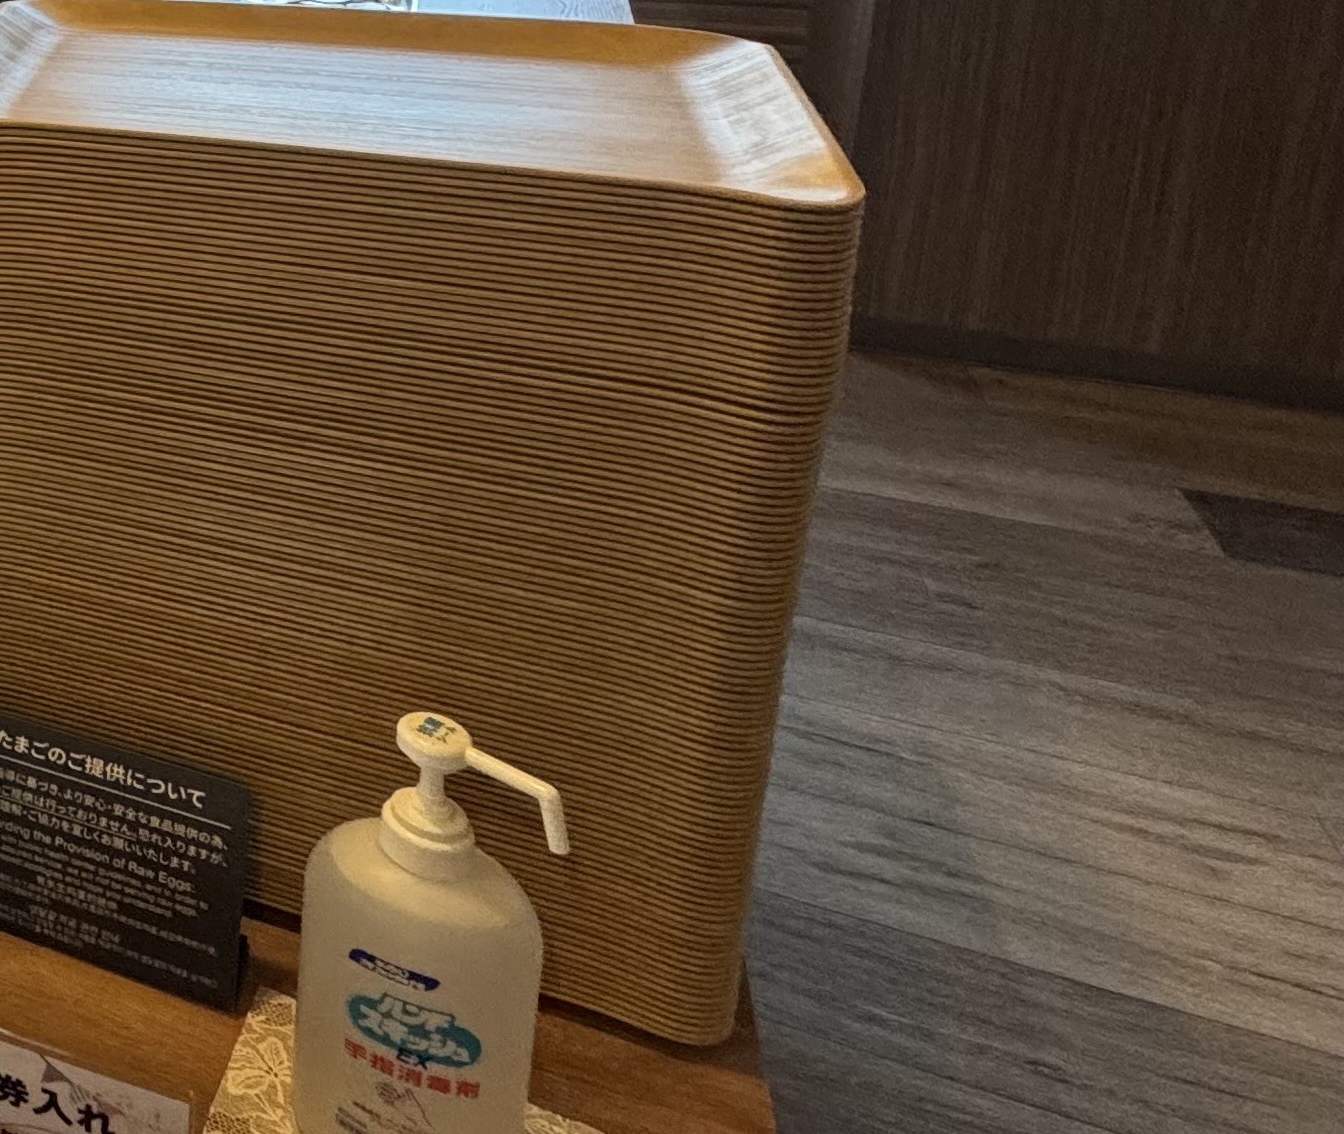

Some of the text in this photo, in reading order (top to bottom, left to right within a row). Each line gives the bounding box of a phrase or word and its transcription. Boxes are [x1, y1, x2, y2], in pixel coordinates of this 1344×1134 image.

[33, 830, 52, 847] the
[54, 833, 110, 865] Provision
[112, 853, 126, 869] of
[127, 859, 156, 878] Raw
[396, 1047, 432, 1070] EX
